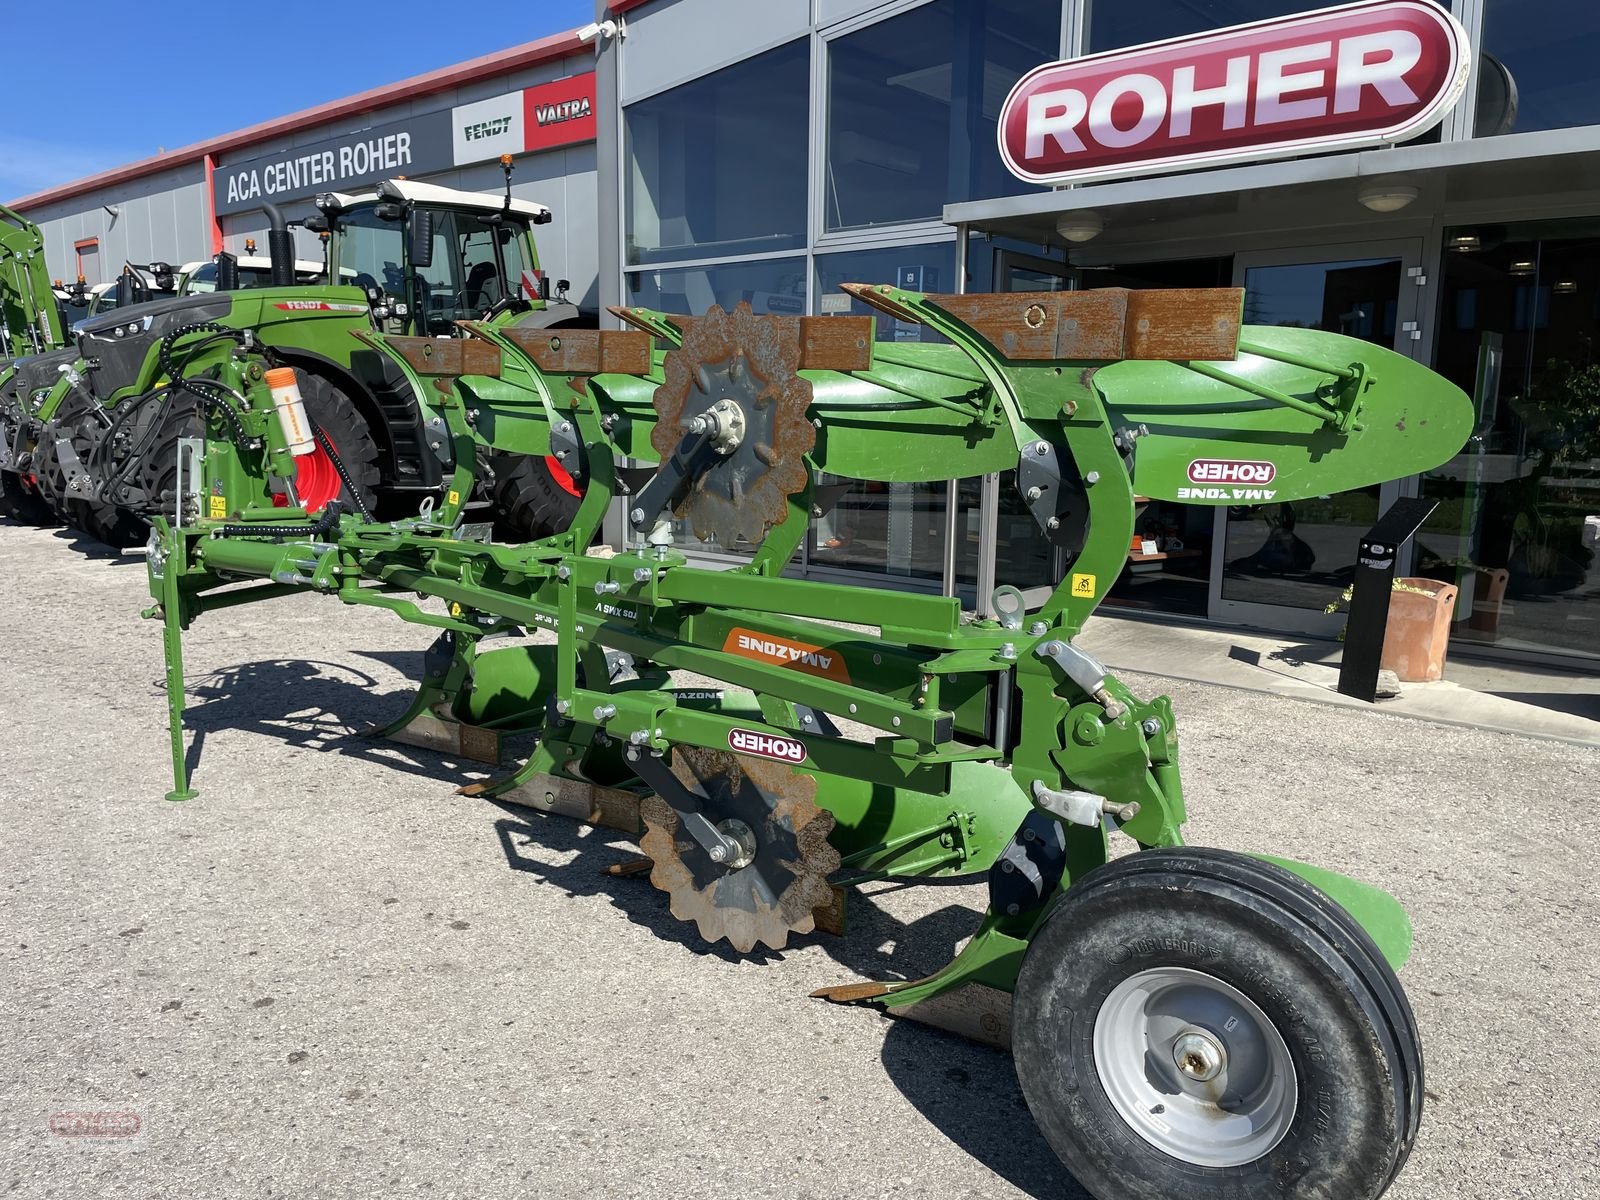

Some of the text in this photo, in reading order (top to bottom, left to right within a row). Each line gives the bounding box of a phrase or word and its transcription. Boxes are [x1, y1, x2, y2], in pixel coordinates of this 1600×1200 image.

[1024, 29, 1422, 160] ROHER
[536, 97, 592, 125] VALTRA
[464, 115, 512, 142] FENDT
[227, 132, 412, 203] ACA CENTER ROHER
[286, 301, 323, 310] FENDT
[1193, 463, 1271, 481] ROHER
[594, 601, 603, 612] V
[603, 604, 622, 617] XMS
[738, 636, 833, 671] AMAZONE
[732, 730, 803, 760] ROHER
